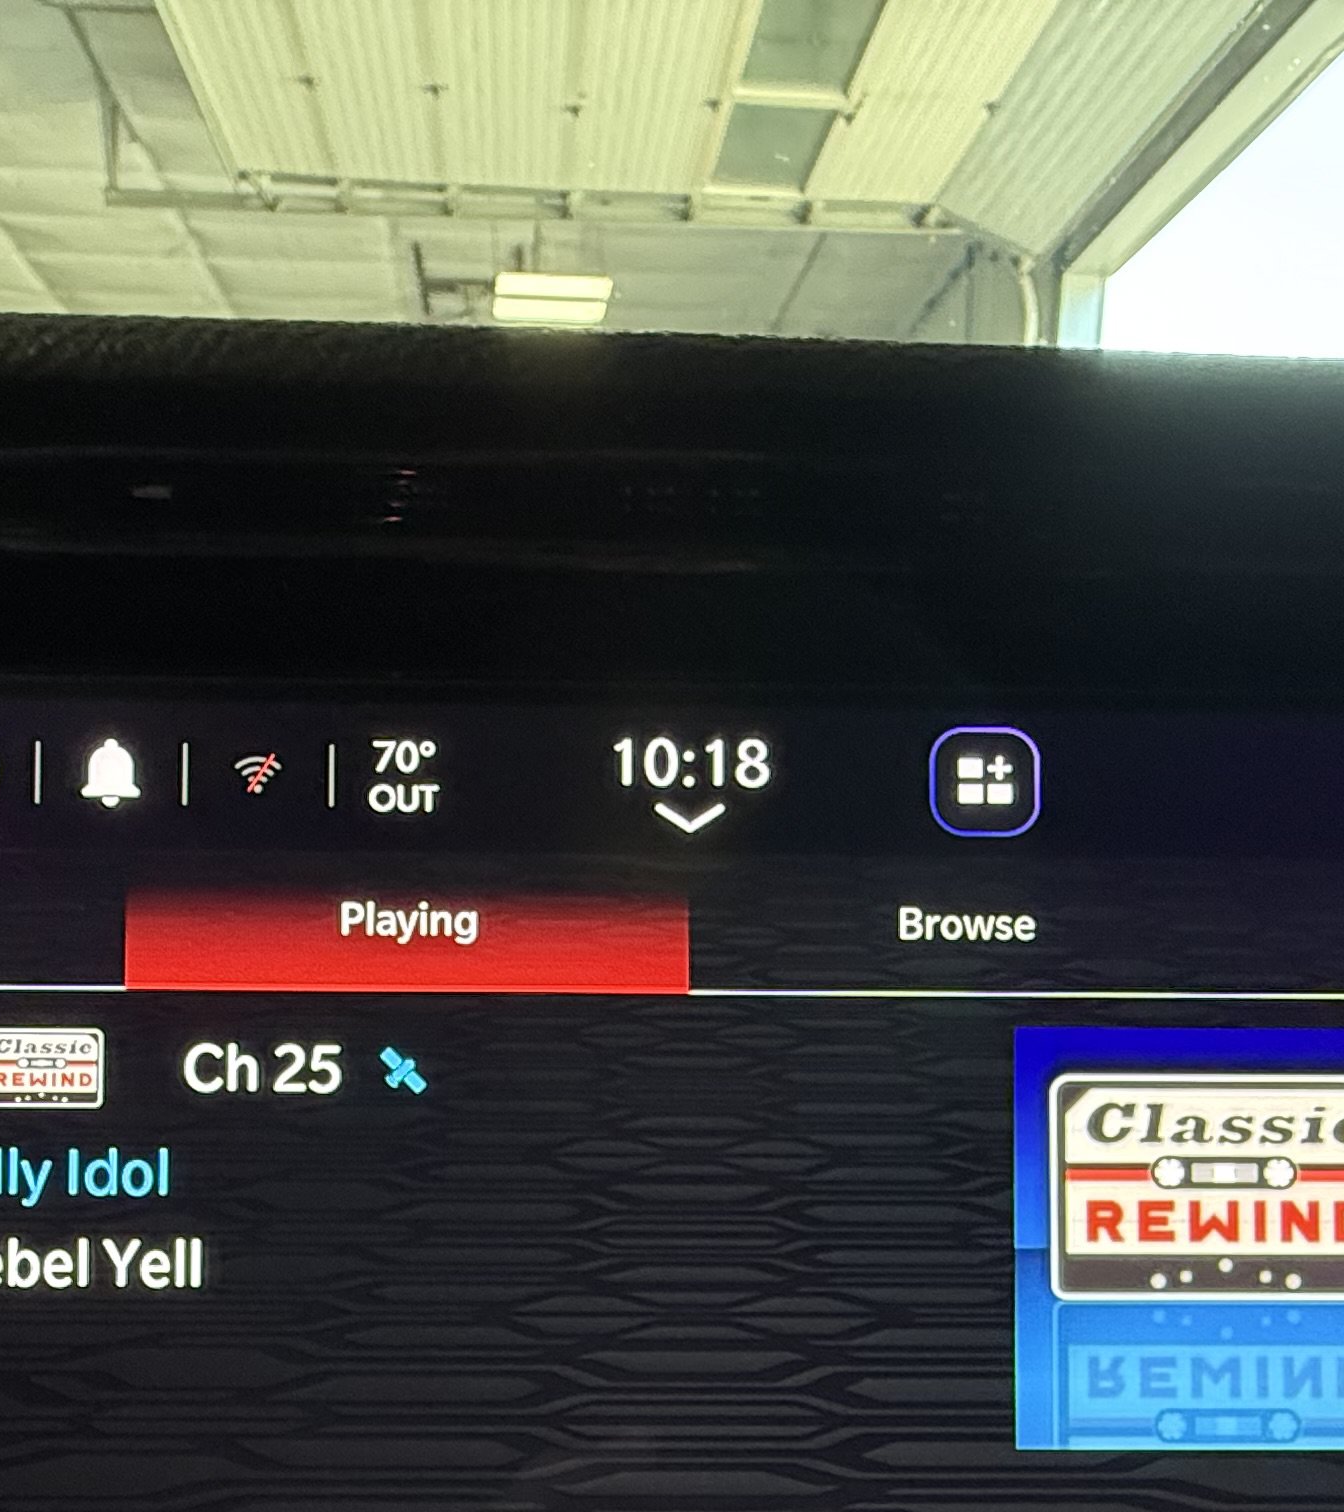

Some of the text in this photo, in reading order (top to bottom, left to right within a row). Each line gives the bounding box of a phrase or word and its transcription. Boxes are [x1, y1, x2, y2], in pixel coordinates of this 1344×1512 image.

[612, 735, 772, 790] 10:18
[367, 782, 442, 814] OUT
[339, 899, 480, 946] Playing
[898, 905, 1037, 943] Browse
[182, 1041, 344, 1096] Ch 25
[66, 1145, 170, 1199] Idol
[100, 1235, 203, 1291] Yell
